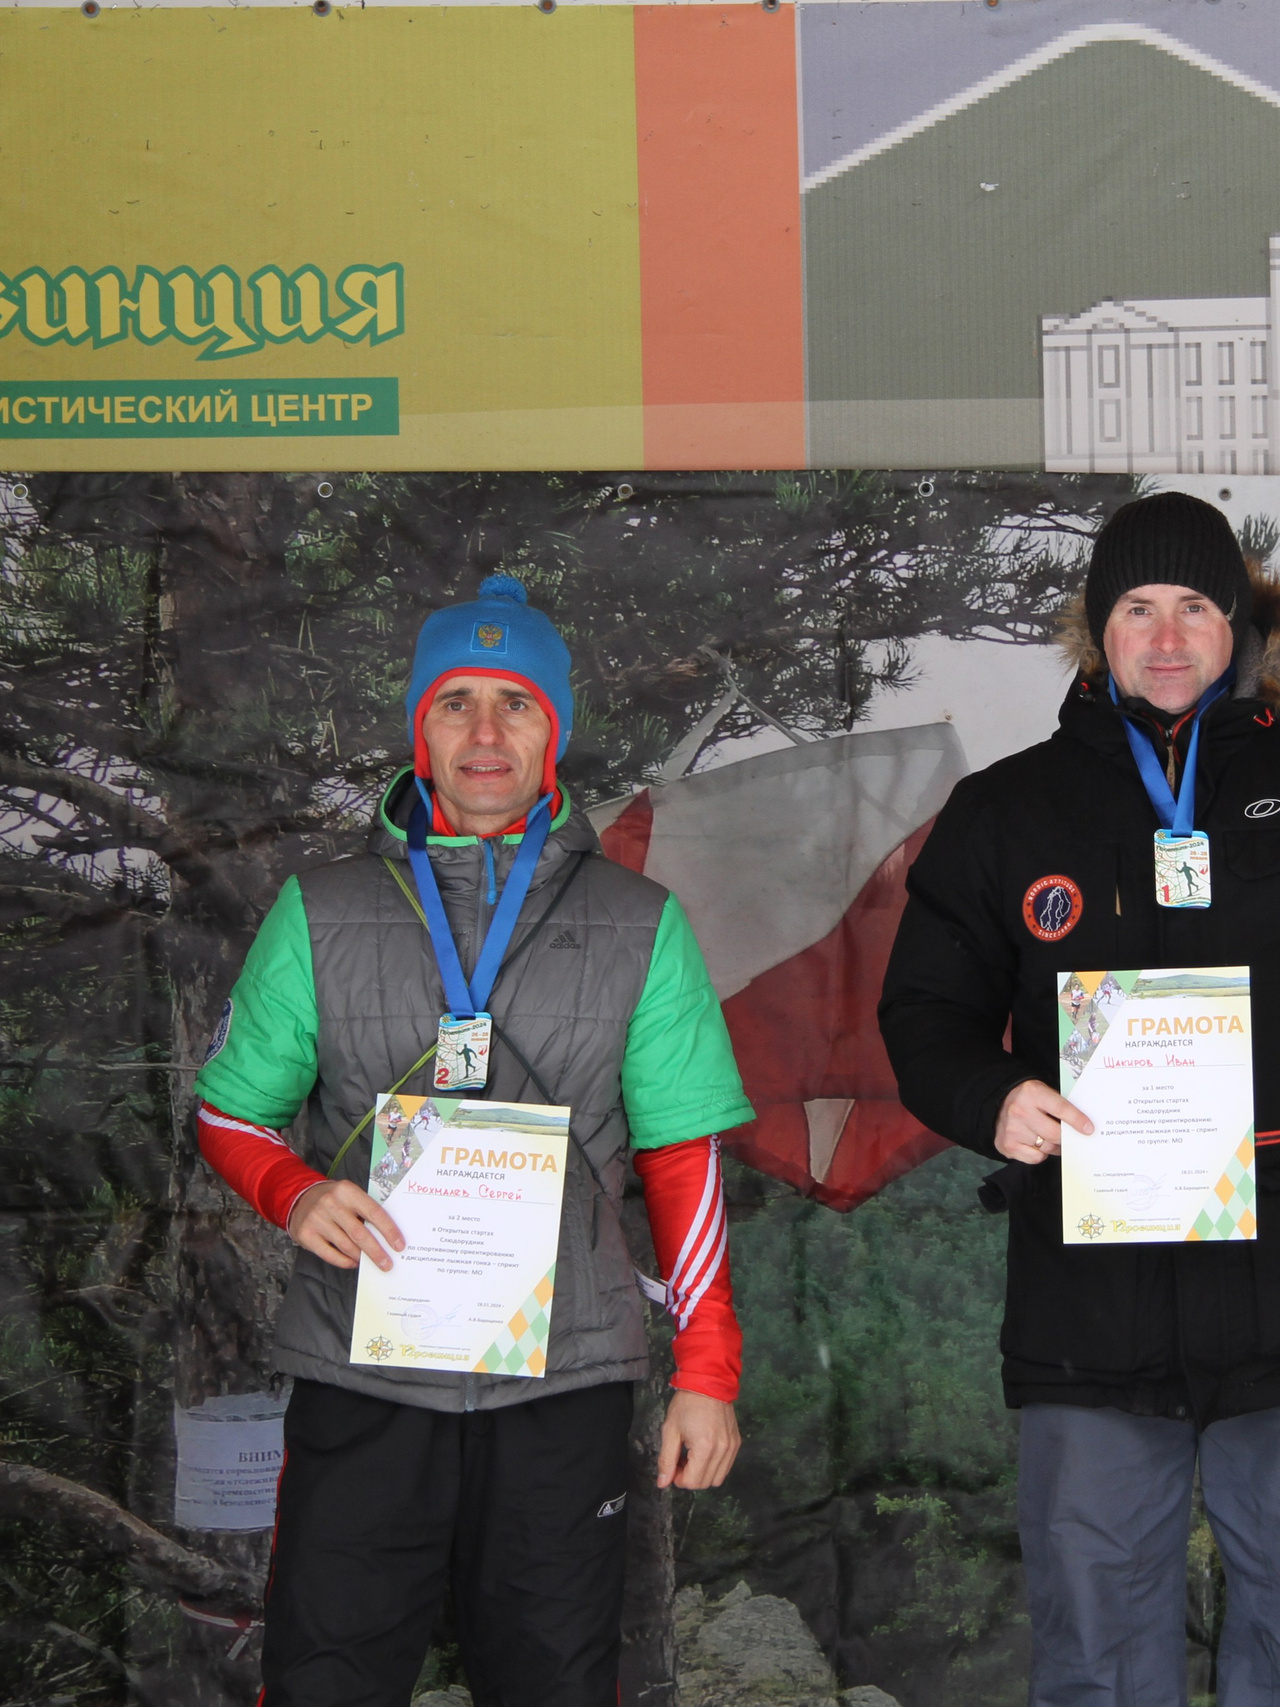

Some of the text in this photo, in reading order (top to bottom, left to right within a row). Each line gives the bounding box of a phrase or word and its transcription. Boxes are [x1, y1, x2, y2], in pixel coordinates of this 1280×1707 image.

[251, 393, 373, 427] ЦЕНТР
[1162, 885, 1170, 902] 1
[1127, 1015, 1244, 1036] ГРАМОТА
[1125, 1039, 1193, 1049] НАГРАЖДАЕТСЯ
[1165, 1054, 1195, 1067] Иван
[436, 1068, 449, 1084] 2
[1115, 1118, 1157, 1126] спортивному
[1157, 1117, 1212, 1125] ориентированию
[440, 1146, 558, 1173] ГРАМОТА
[436, 1168, 505, 1181] НАГРАЖДАЕТСЯ
[478, 1184, 523, 1201] Сергей
[437, 1226, 469, 1235] Открытых
[439, 1237, 484, 1246] Слюдорудник
[417, 1246, 459, 1254] спортивному
[460, 1249, 514, 1258] ориентированию
